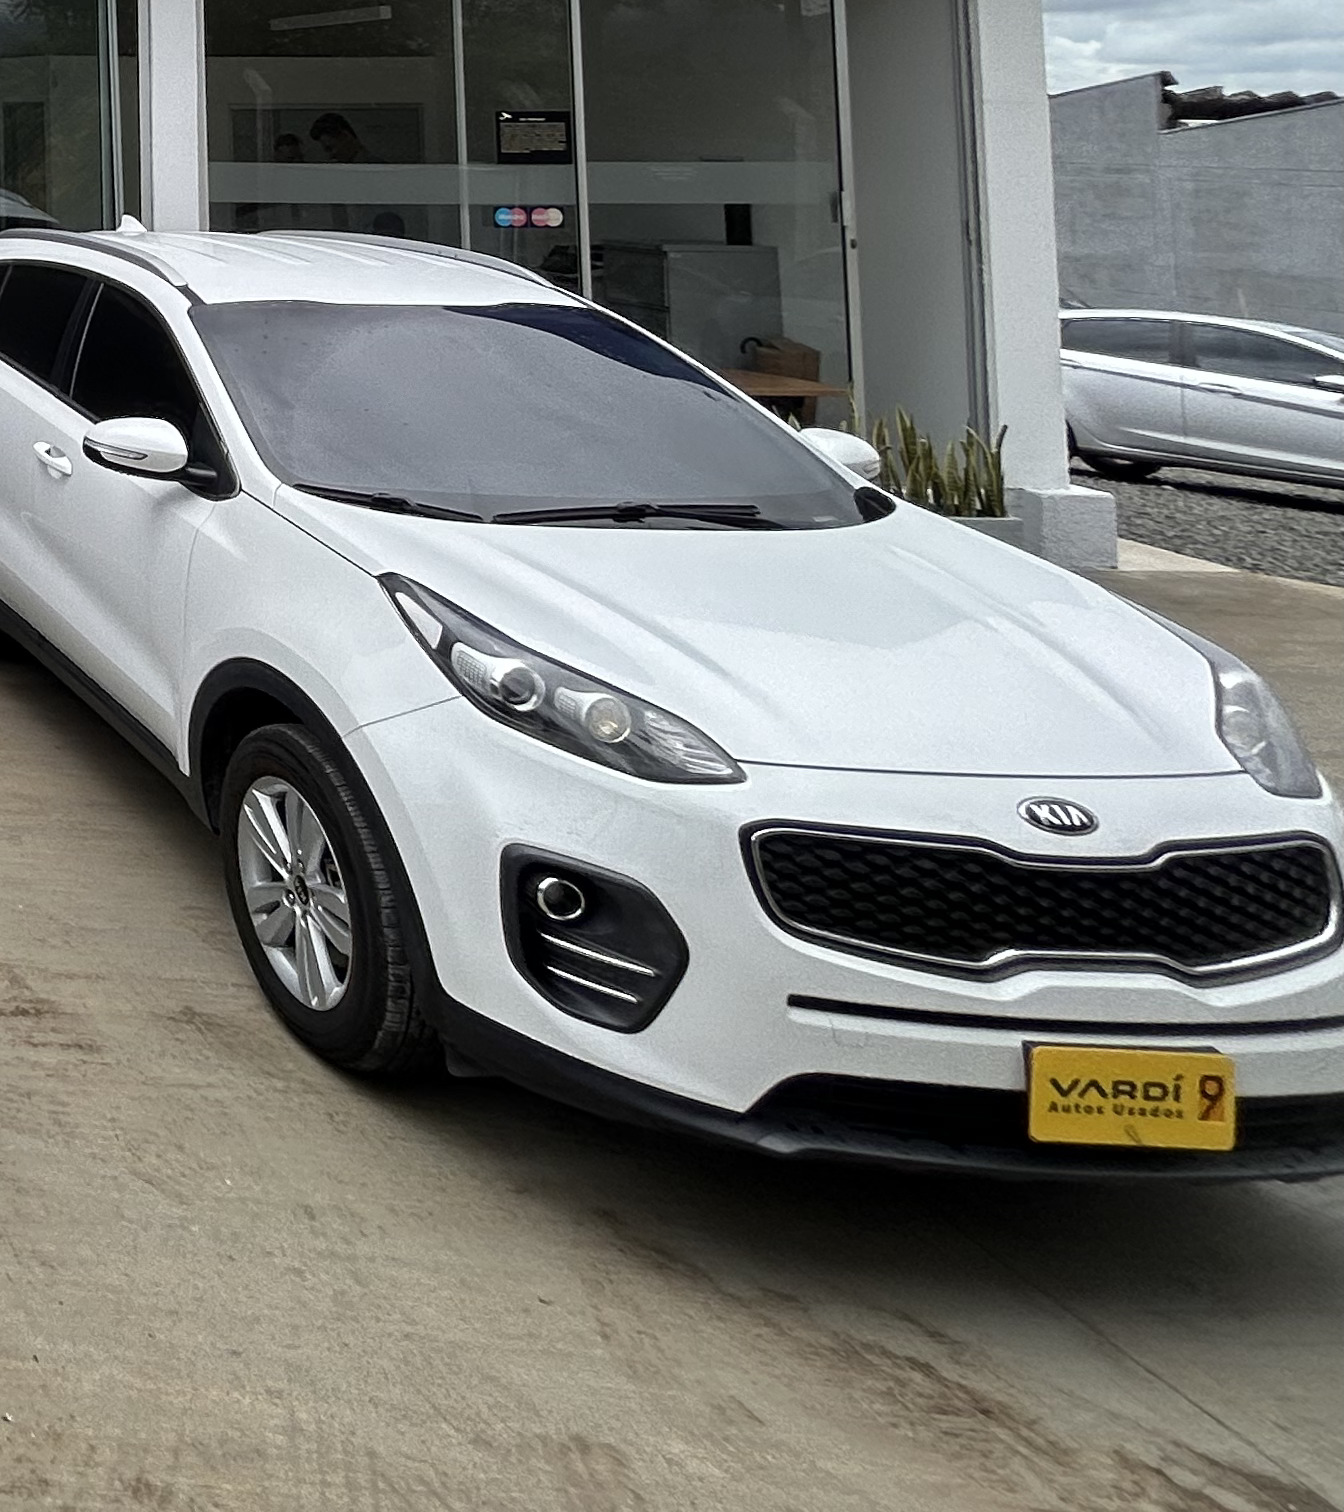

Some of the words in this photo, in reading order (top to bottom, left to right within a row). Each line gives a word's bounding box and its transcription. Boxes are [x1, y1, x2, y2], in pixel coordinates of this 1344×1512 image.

[1029, 803, 1091, 826] KIA
[1049, 1072, 1184, 1103] VARDÍ
[1197, 1074, 1225, 1121] 9
[1047, 1100, 1105, 1115] Autos
[1113, 1103, 1185, 1120] Usados
